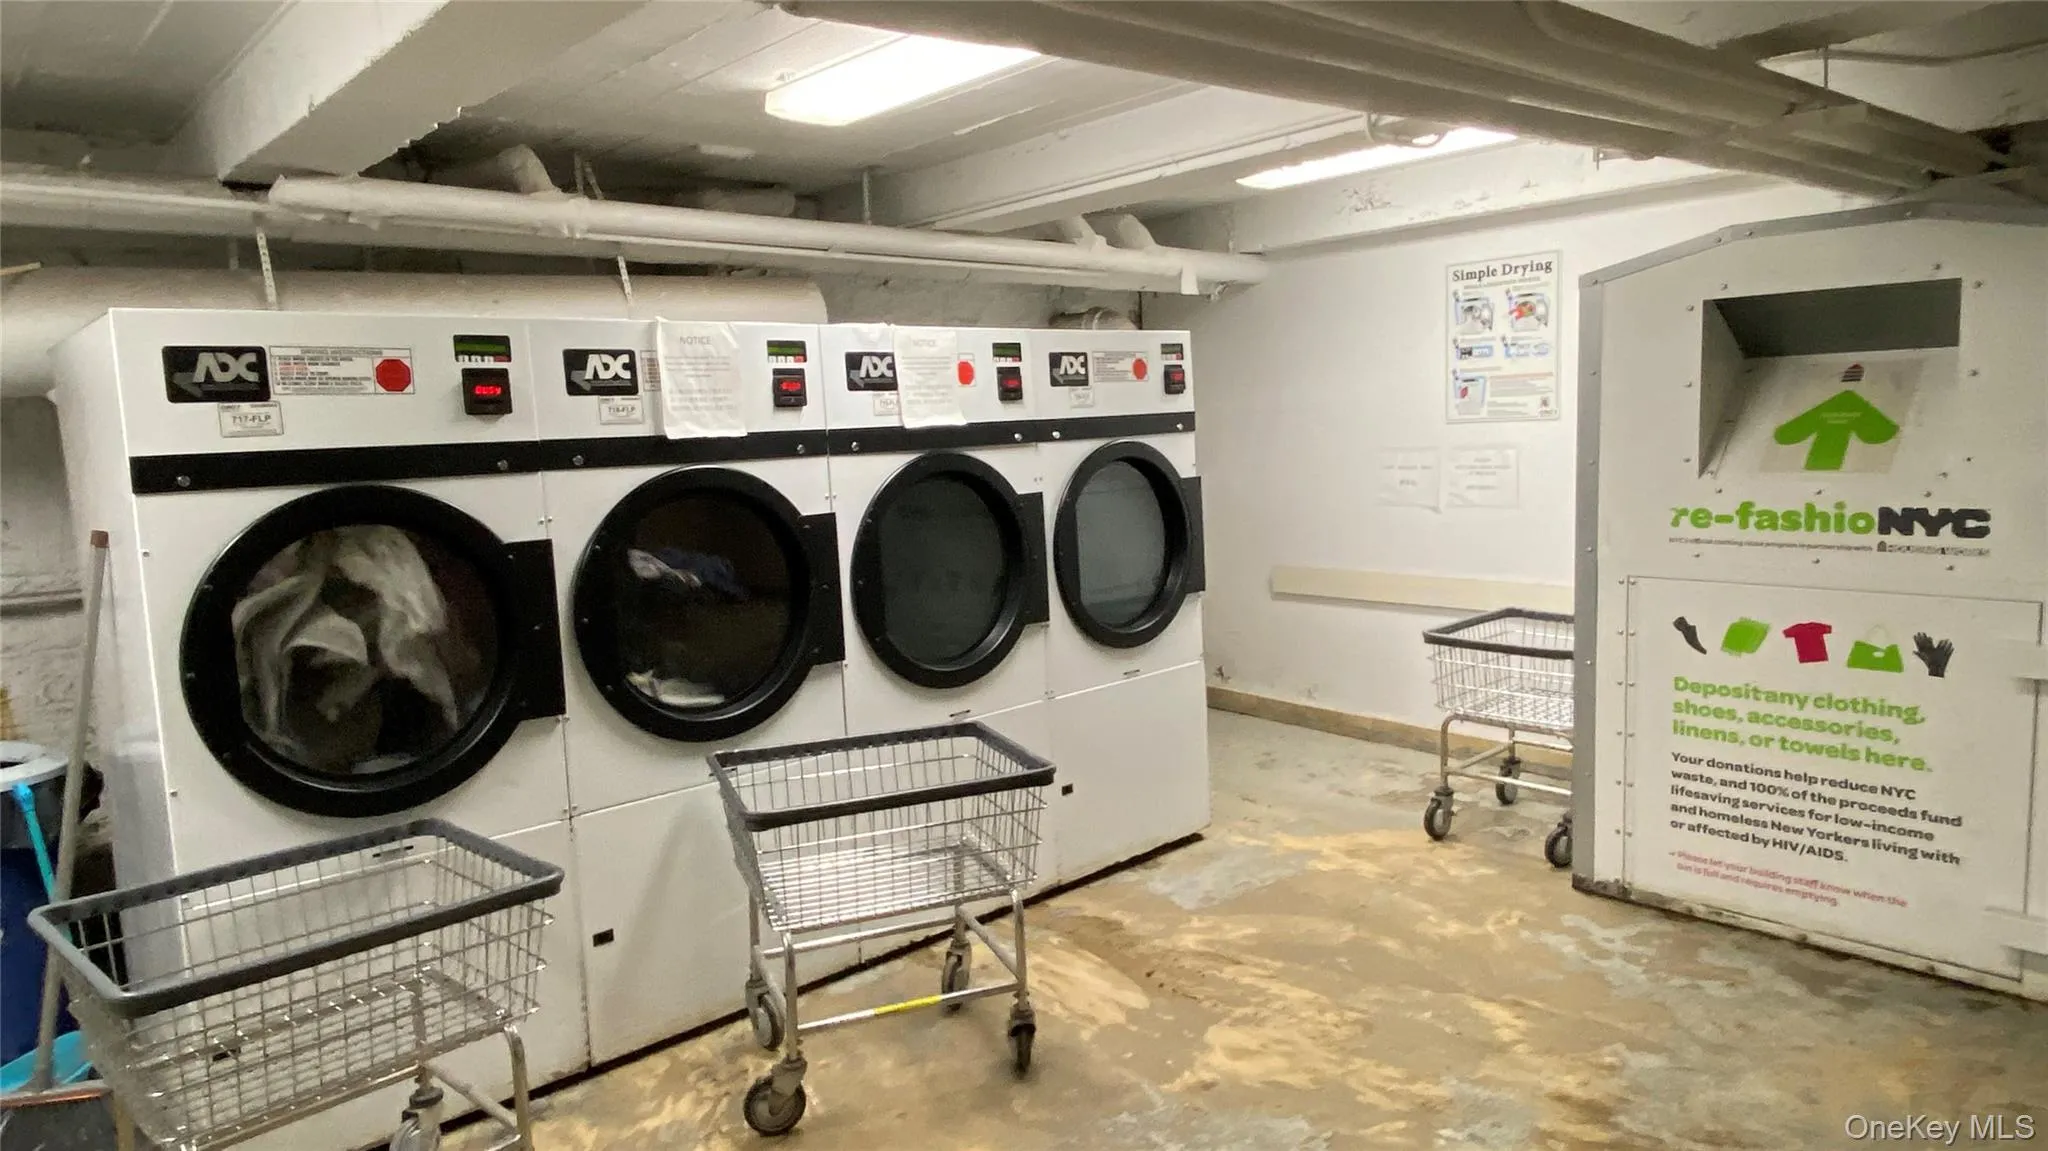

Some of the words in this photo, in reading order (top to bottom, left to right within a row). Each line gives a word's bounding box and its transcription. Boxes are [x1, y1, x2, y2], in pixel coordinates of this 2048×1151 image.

[1452, 265, 1497, 282] Simple
[1502, 260, 1553, 277] Drying
[192, 352, 259, 382] ADC
[584, 353, 631, 380] ADC
[860, 355, 894, 378] ADC
[1059, 355, 1086, 375] ADC
[1672, 698, 1744, 724] shoes,
[1747, 711, 1900, 745] accessories,
[1672, 719, 1745, 746] linens,
[1748, 734, 1775, 748] or
[1778, 736, 1861, 761] towels
[1865, 746, 1933, 772] here.
[1671, 752, 1704, 765] Your
[1707, 758, 1781, 778] donations
[1784, 769, 1819, 785] help
[1820, 777, 1878, 794] reduce
[1881, 785, 1916, 800] NYC
[1671, 770, 1718, 786] waste,
[1720, 780, 1747, 790] and
[1750, 782, 1789, 797] 100%
[1791, 790, 1808, 800] of
[1810, 792, 1837, 806] the
[1839, 798, 1917, 819] proceeds
[1921, 810, 1962, 827] fund
[1671, 785, 1740, 809] lifesaving
[1742, 800, 1806, 818] services
[1808, 809, 1832, 822] for
[1835, 814, 1935, 841] low-income
[1670, 820, 1686, 829] or
[1687, 823, 1749, 842] affected
[1752, 833, 1771, 848] by
[1772, 838, 1848, 862] HIV/AIDS.
[1671, 803, 1697, 815] and
[1699, 806, 1768, 829] homeless
[1771, 820, 1804, 835] New
[1807, 827, 1870, 848] Yorkers
[1872, 839, 1918, 860] living
[1920, 849, 1961, 865] with
[1677, 850, 1708, 864] Please
[1709, 858, 1722, 867] let
[1724, 863, 1748, 873] your
[1749, 865, 1791, 884] building
[1853, 889, 1884, 902] when
[1720, 873, 1740, 883] and
